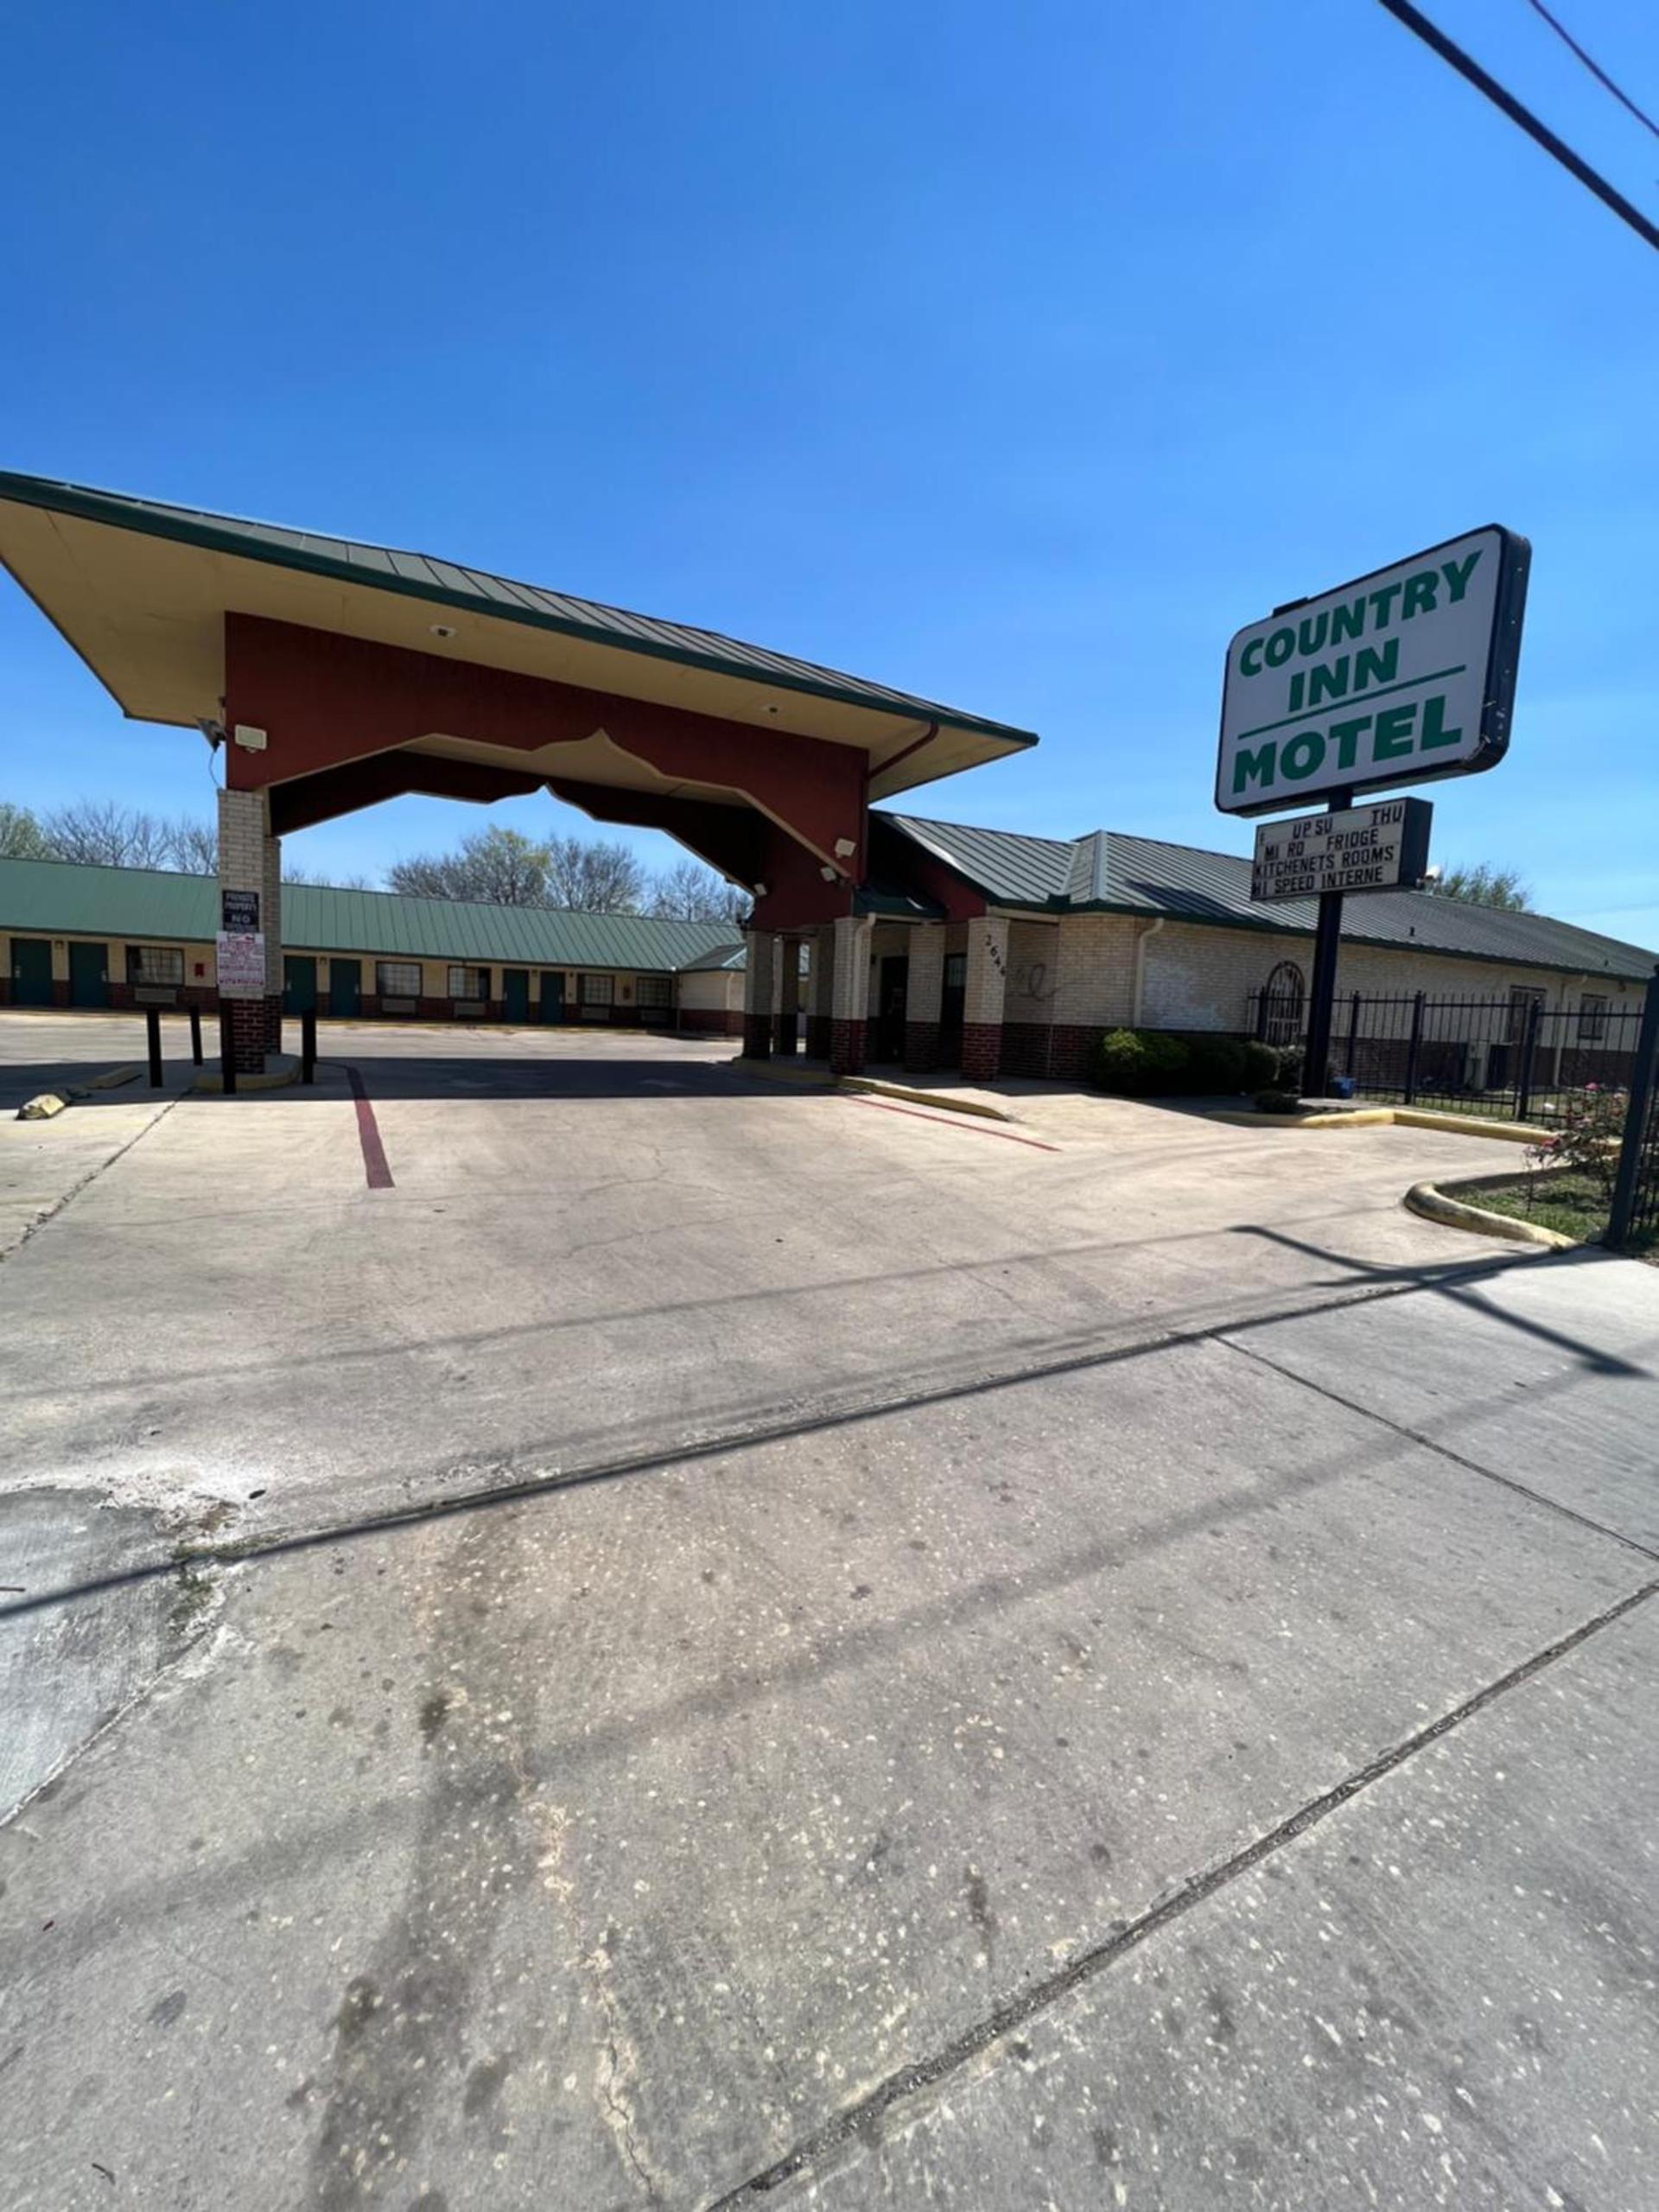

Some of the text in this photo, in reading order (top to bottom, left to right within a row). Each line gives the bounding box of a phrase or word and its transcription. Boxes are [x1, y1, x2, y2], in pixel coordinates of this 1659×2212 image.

[1240, 550, 1483, 677] COUNTRY
[1287, 637, 1400, 713] INN
[1232, 696, 1463, 794] MOTEL
[1326, 828, 1379, 852] FRIDGE
[1254, 845, 1395, 879] KITCHENETS ROOMS
[1274, 874, 1315, 894] SPEED
[1321, 866, 1382, 889] INTERNE
[232, 913, 251, 925] NO
